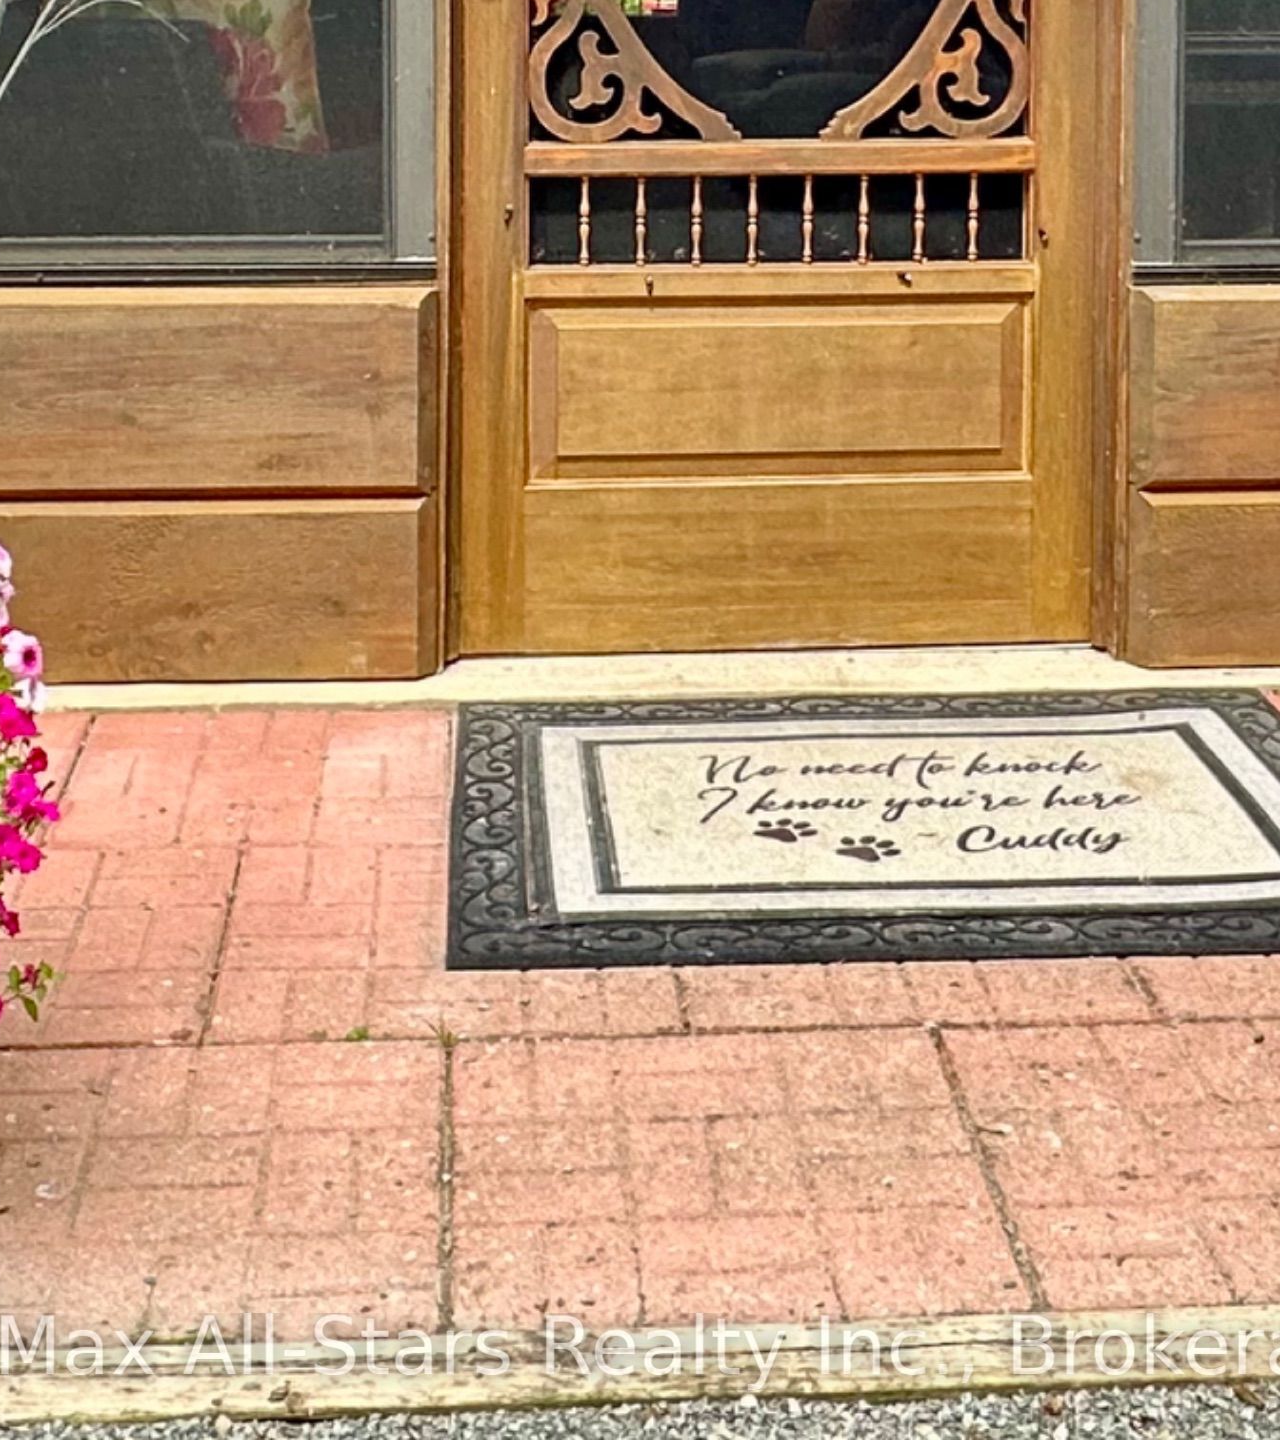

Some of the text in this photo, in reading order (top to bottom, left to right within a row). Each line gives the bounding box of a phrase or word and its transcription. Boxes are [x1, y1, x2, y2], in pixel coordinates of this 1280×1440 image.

[698, 750, 1103, 790] No need to knock
[746, 788, 872, 815] know
[881, 789, 1031, 823] you're
[1043, 784, 1142, 810] here
[956, 824, 1130, 854] Cuddy
